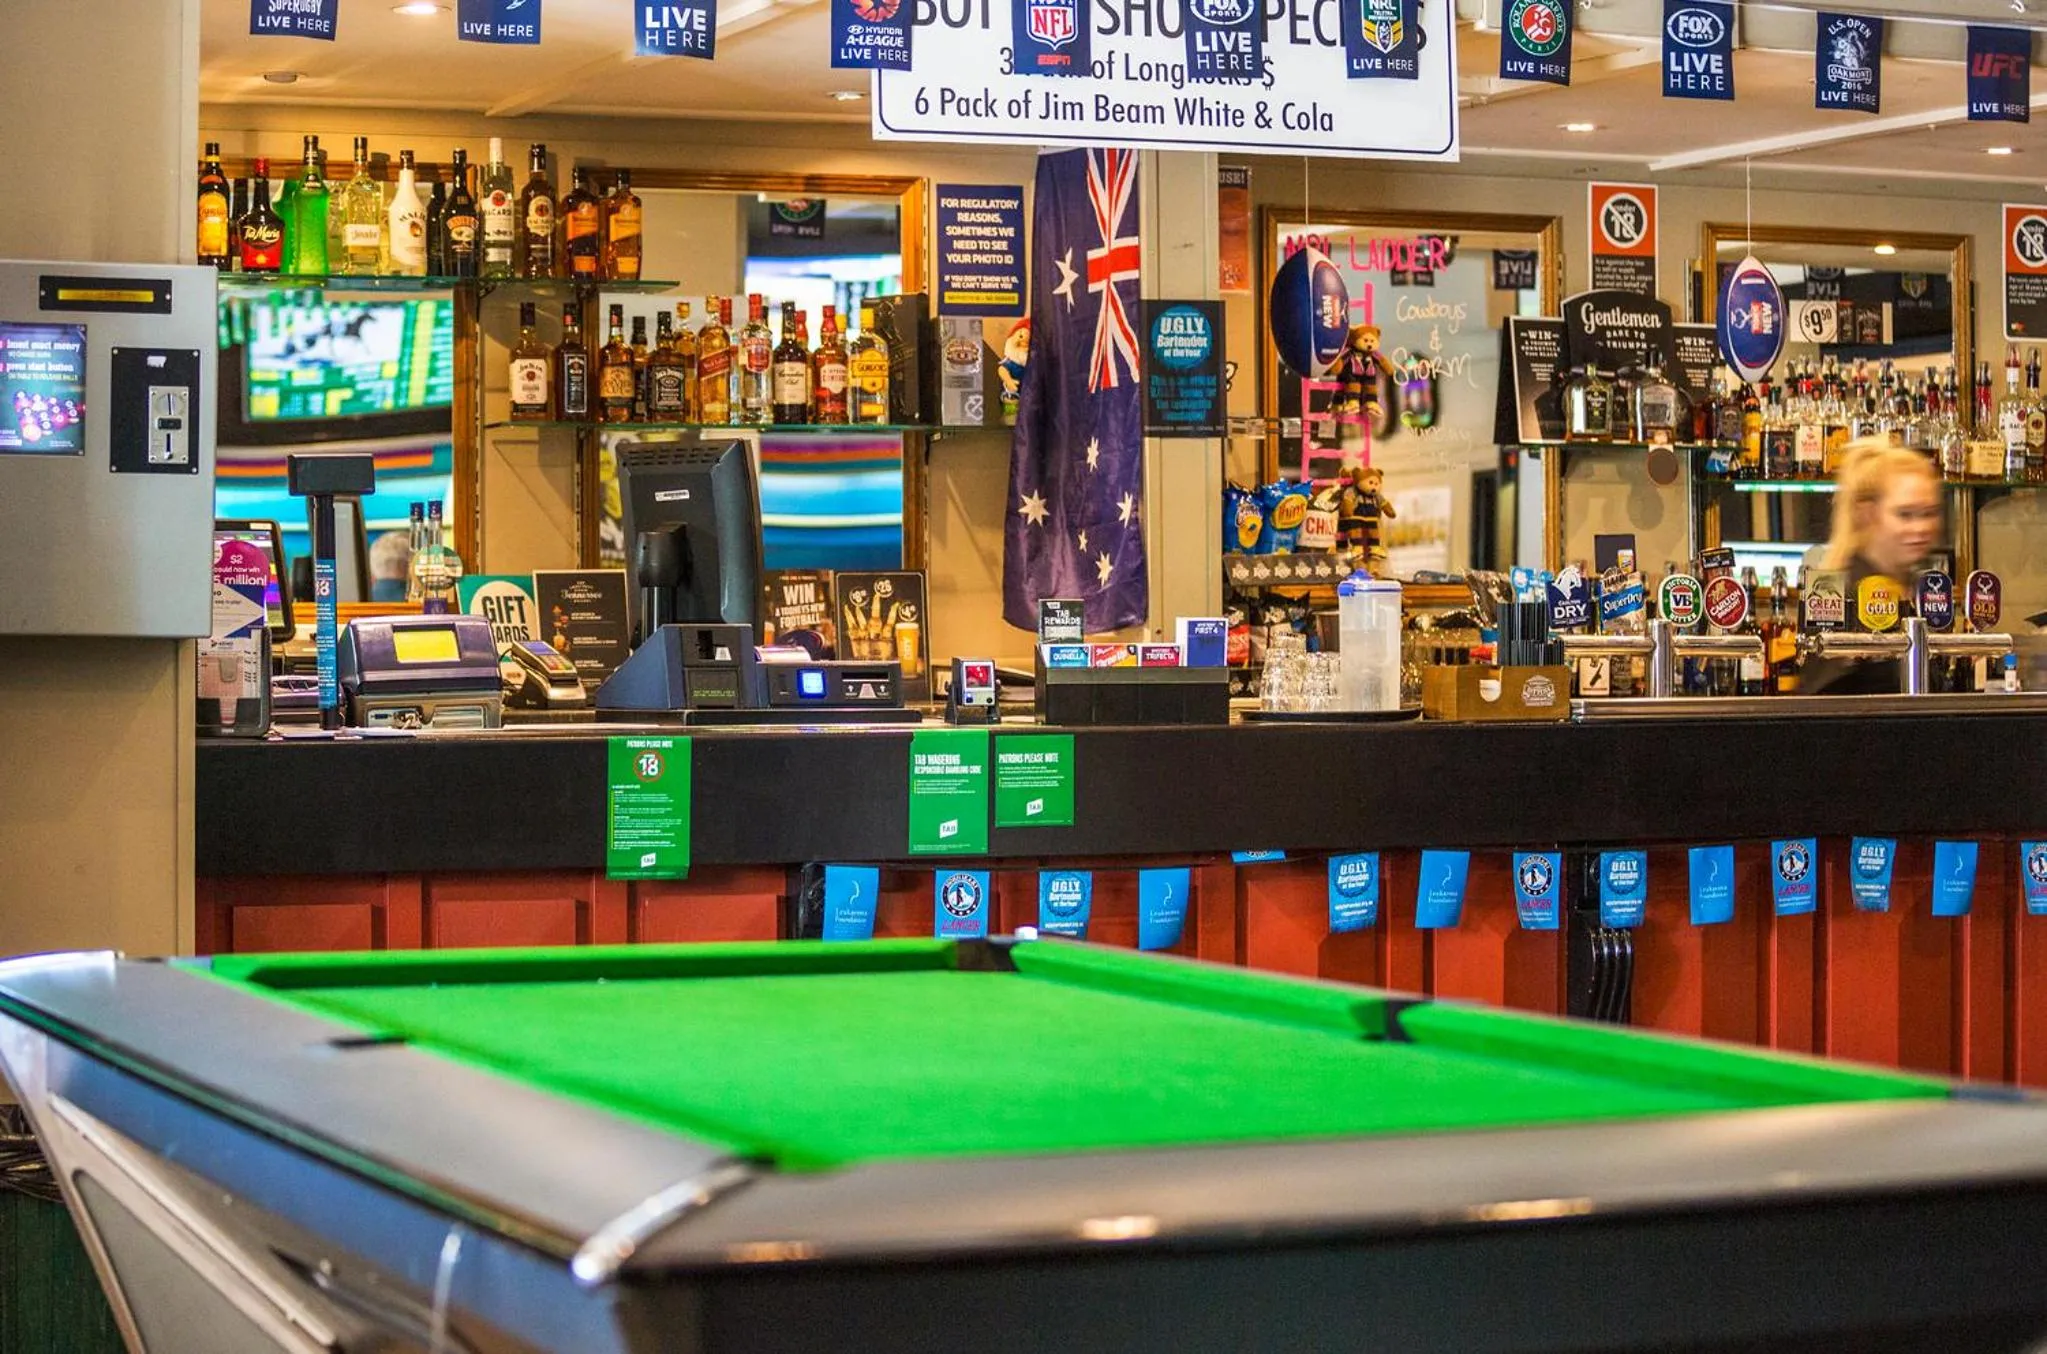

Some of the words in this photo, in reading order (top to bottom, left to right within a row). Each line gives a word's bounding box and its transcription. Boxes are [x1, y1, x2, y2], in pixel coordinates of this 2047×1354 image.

[258, 16, 291, 28] LIVE
[297, 19, 330, 32] HERE
[646, 7, 706, 31] LIVE
[1033, 8, 1073, 36] NFL
[1678, 16, 1713, 34] FOX
[463, 22, 491, 35] LIVE
[497, 24, 533, 37] HERE
[865, 26, 903, 36] HYUNDAI
[1846, 18, 1871, 38] OPEN
[645, 31, 706, 49] HERE
[846, 36, 904, 48] A-LEAGUE
[1195, 32, 1253, 53] LIVE
[1678, 32, 1715, 41] SPORTS
[840, 48, 872, 60] LIVE
[878, 49, 909, 62] HERE
[1196, 53, 1254, 70] HERE
[1000, 46, 1014, 76] 3
[1092, 50, 1115, 80] of
[1262, 56, 1275, 91] $
[1353, 58, 1382, 70] LIVE
[1387, 59, 1414, 71] HERE
[1506, 60, 1535, 73] LIVE
[1539, 63, 1566, 77] HERE
[1670, 52, 1724, 74] LIVE
[1971, 53, 2025, 80] UFC
[1669, 74, 1725, 91] HERE
[1841, 81, 1862, 91] 2016
[1821, 91, 1848, 102] LIVE
[1852, 93, 1877, 106] HERE
[914, 86, 929, 116] 6
[940, 87, 998, 118] Pack
[1007, 89, 1033, 120] of
[1039, 91, 1084, 121] Jim
[1095, 94, 1165, 125] Beam
[1174, 97, 1245, 128] White
[1254, 101, 1273, 130] &
[1282, 102, 1334, 132] Cola
[1972, 103, 1999, 113] LIVE
[2003, 104, 2026, 115] HERE
[941, 198, 959, 209] FOR
[960, 199, 1019, 210] REGULATORY
[945, 225, 998, 237] SOMETIMES
[998, 226, 1015, 237] WE
[1610, 213, 1636, 238] 18
[952, 240, 977, 251] NEED
[978, 240, 990, 250] TO
[991, 241, 1008, 251] SEE
[2023, 233, 2044, 257] 18
[946, 253, 971, 264] YOUR
[972, 254, 1003, 265] PHOTO
[1004, 254, 1014, 265] ID
[1350, 236, 1448, 273] LADDER
[1396, 296, 1468, 334] Cowboys
[1580, 302, 1663, 335] Gentlemen
[1761, 300, 1773, 334] NEW
[1157, 335, 1208, 348] Bartender
[1527, 330, 1552, 340] WIN
[1683, 336, 1706, 346] WIN
[1605, 341, 1648, 349] TRIUMPH
[224, 574, 267, 586] million!
[1665, 576, 1697, 591] VICTORIA
[783, 582, 816, 606] WIN
[1672, 594, 1692, 607] VB
[481, 595, 527, 625] GIFT
[1603, 591, 1643, 615] SuperDry
[1709, 589, 1742, 617] CARLTON
[1808, 598, 1842, 610] GREAT
[1866, 603, 1897, 616] GOLD
[1924, 602, 1948, 613] NEW
[1973, 604, 1996, 613] OLD
[1554, 604, 1587, 619] DRY
[780, 613, 821, 629] FOOTBALL
[1044, 617, 1081, 625] REWARDS
[491, 625, 531, 643] ARDS
[1024, 754, 1043, 763] PLEASE
[639, 757, 659, 776] 18
